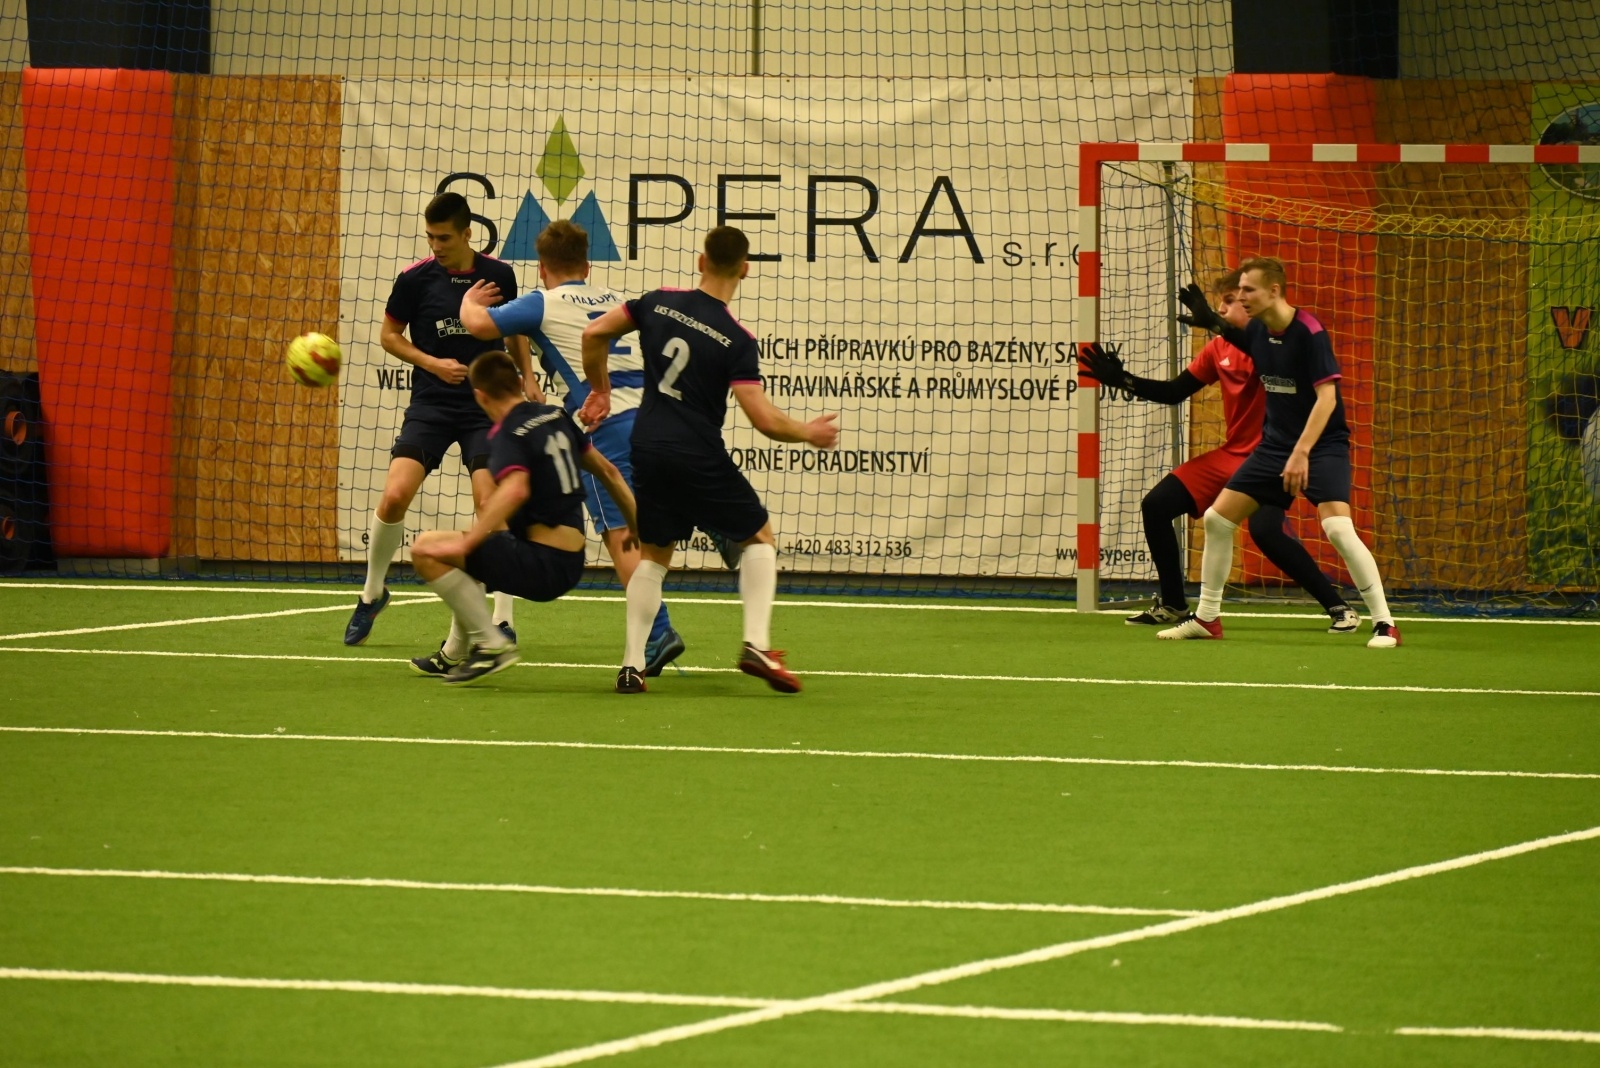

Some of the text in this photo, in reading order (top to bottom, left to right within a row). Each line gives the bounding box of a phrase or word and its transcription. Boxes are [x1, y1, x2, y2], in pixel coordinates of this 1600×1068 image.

[921, 340, 962, 363] PRO
[967, 336, 1049, 367] BAZÉNY,
[658, 336, 690, 401] 2
[907, 377, 921, 399] A
[926, 371, 1060, 401] PRŮMYSLOVÉ
[544, 430, 580, 494] 11
[789, 446, 929, 474] PORADENSTVÍ
[784, 538, 912, 558] +420 483 312 536
